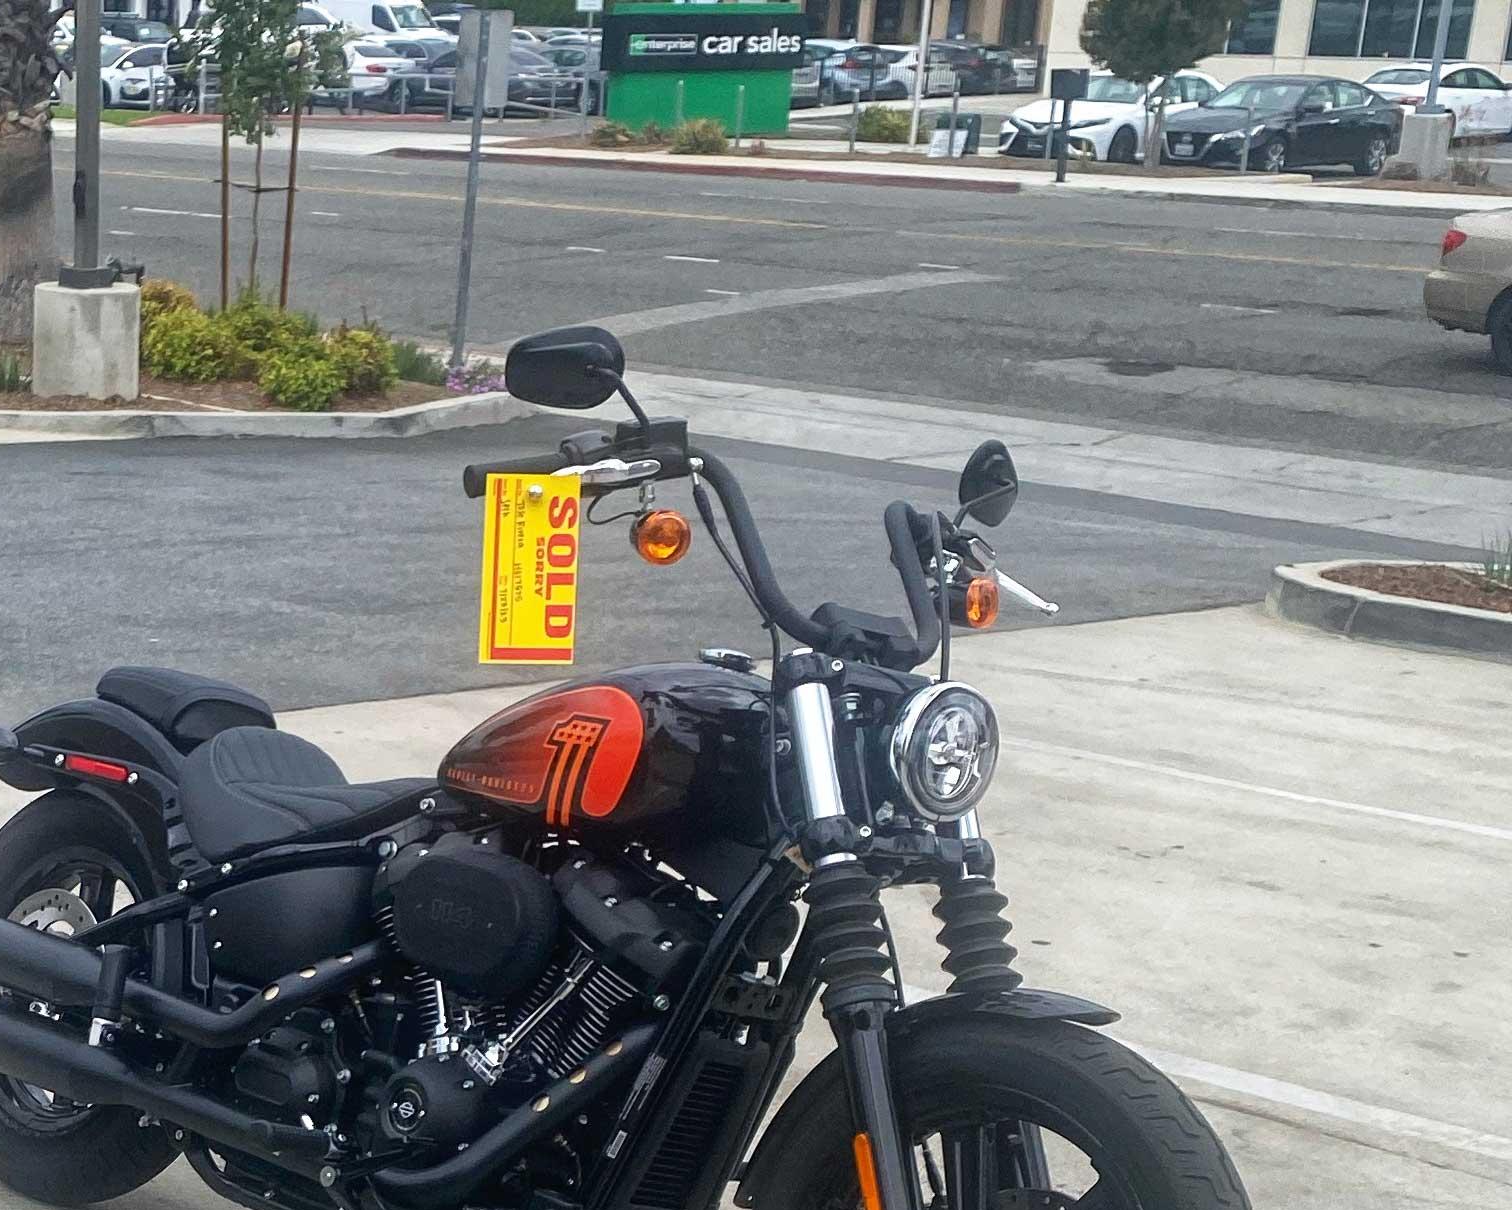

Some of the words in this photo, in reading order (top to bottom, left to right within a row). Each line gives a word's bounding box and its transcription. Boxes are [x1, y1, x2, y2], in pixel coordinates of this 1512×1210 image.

[635, 38, 696, 52] enterprise
[702, 35, 744, 54] car
[747, 27, 801, 54] sales
[535, 537, 546, 598] SORRY
[545, 495, 578, 638] SOLD
